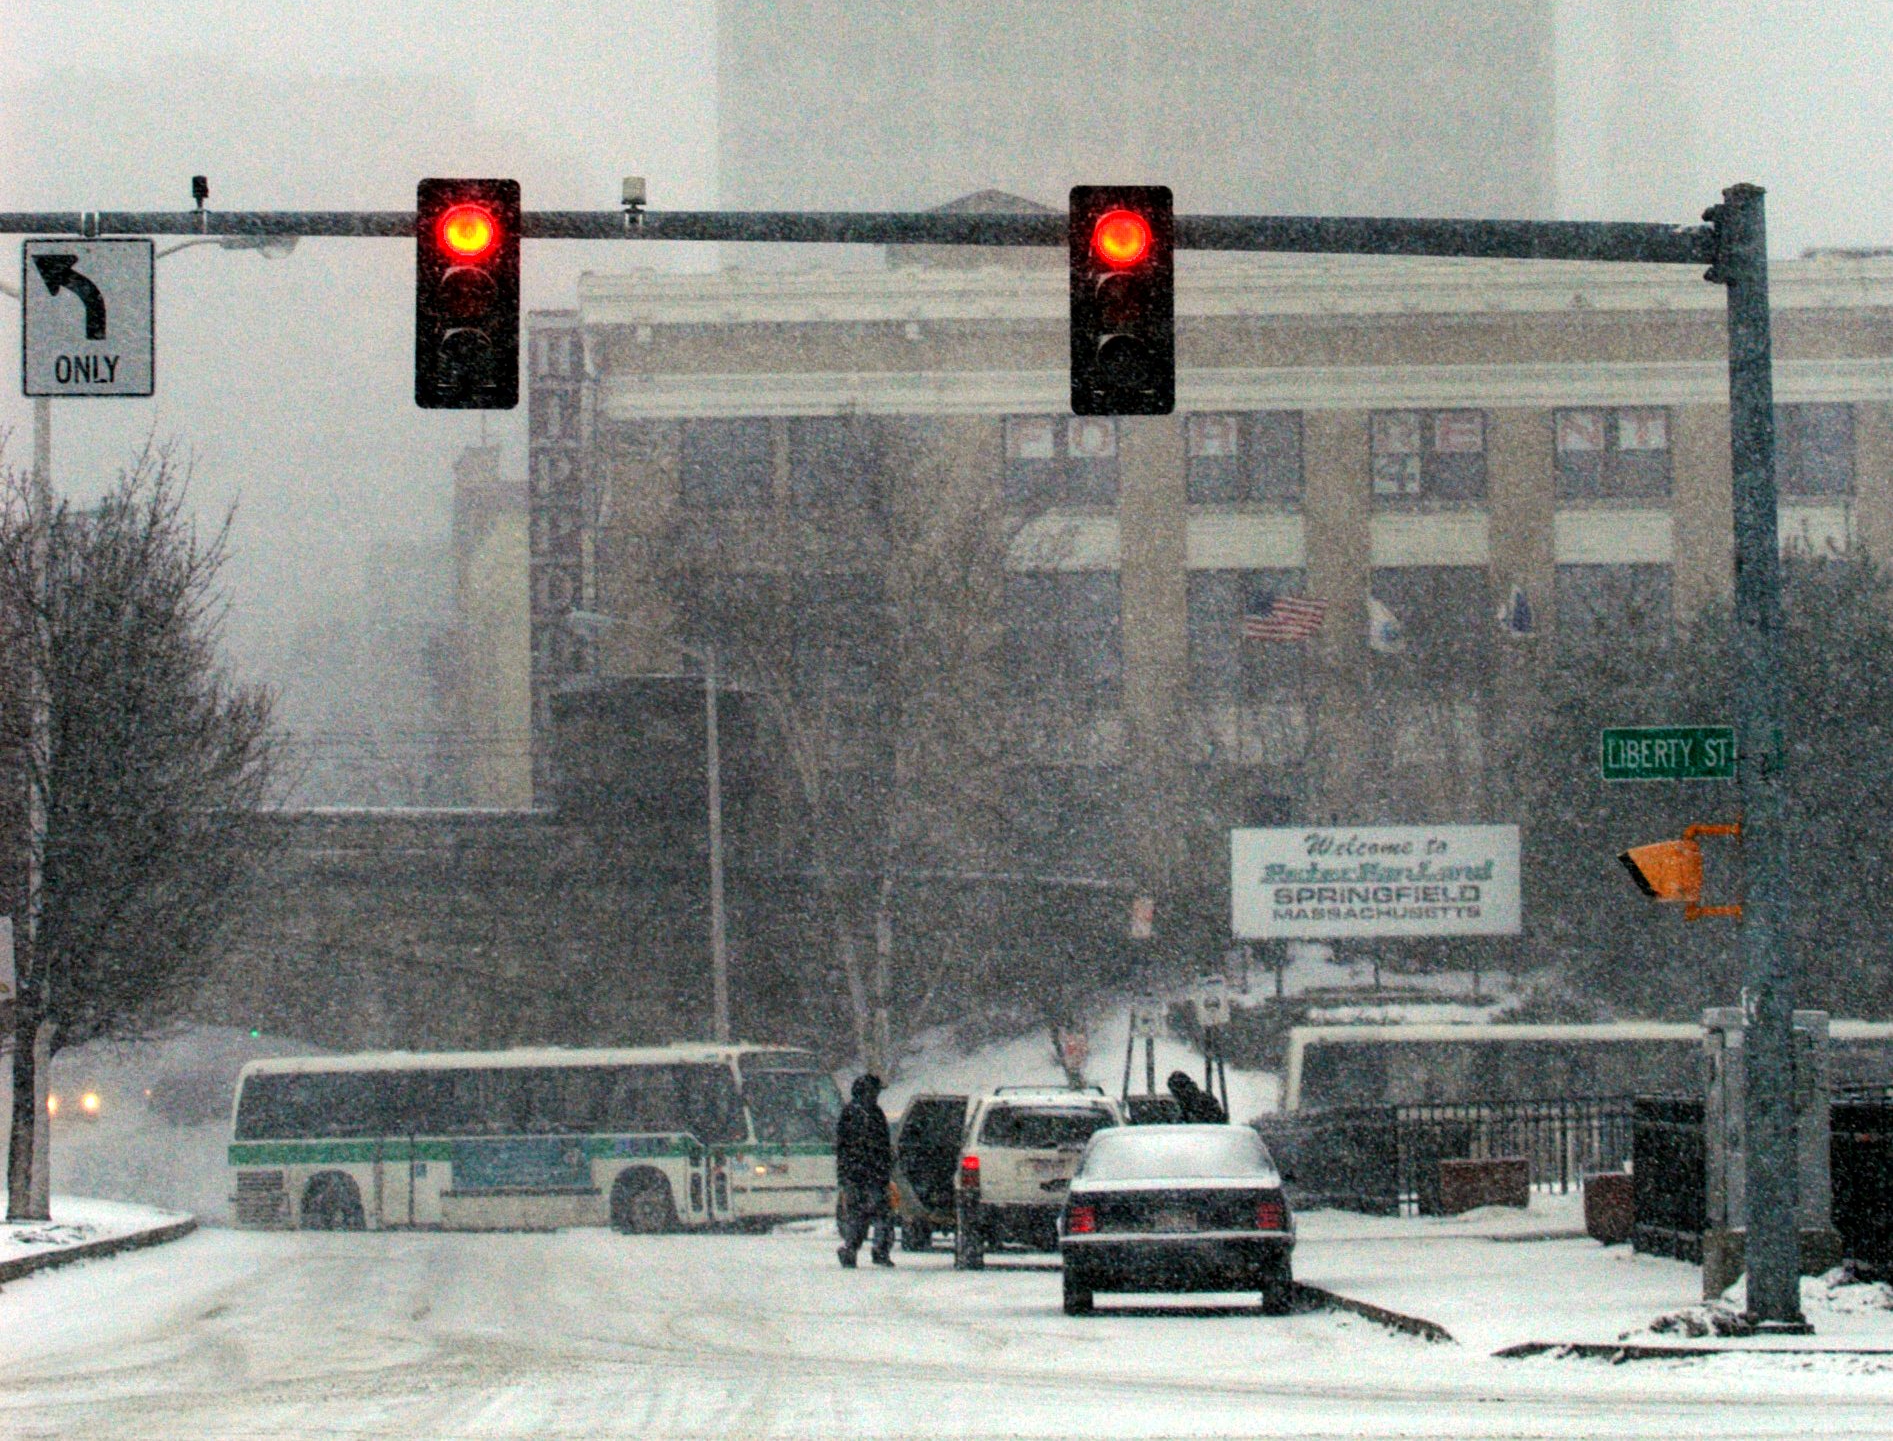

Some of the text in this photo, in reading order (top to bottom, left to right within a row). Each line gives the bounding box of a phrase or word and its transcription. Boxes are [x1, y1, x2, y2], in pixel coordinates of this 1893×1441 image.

[55, 355, 120, 383] ONLY
[1608, 738, 1729, 768] LIBERTY ST
[1304, 833, 1448, 857] Welcome to
[1273, 885, 1481, 905] SPRINGFIELD
[1272, 906, 1482, 922] MASSACHUSETTS
